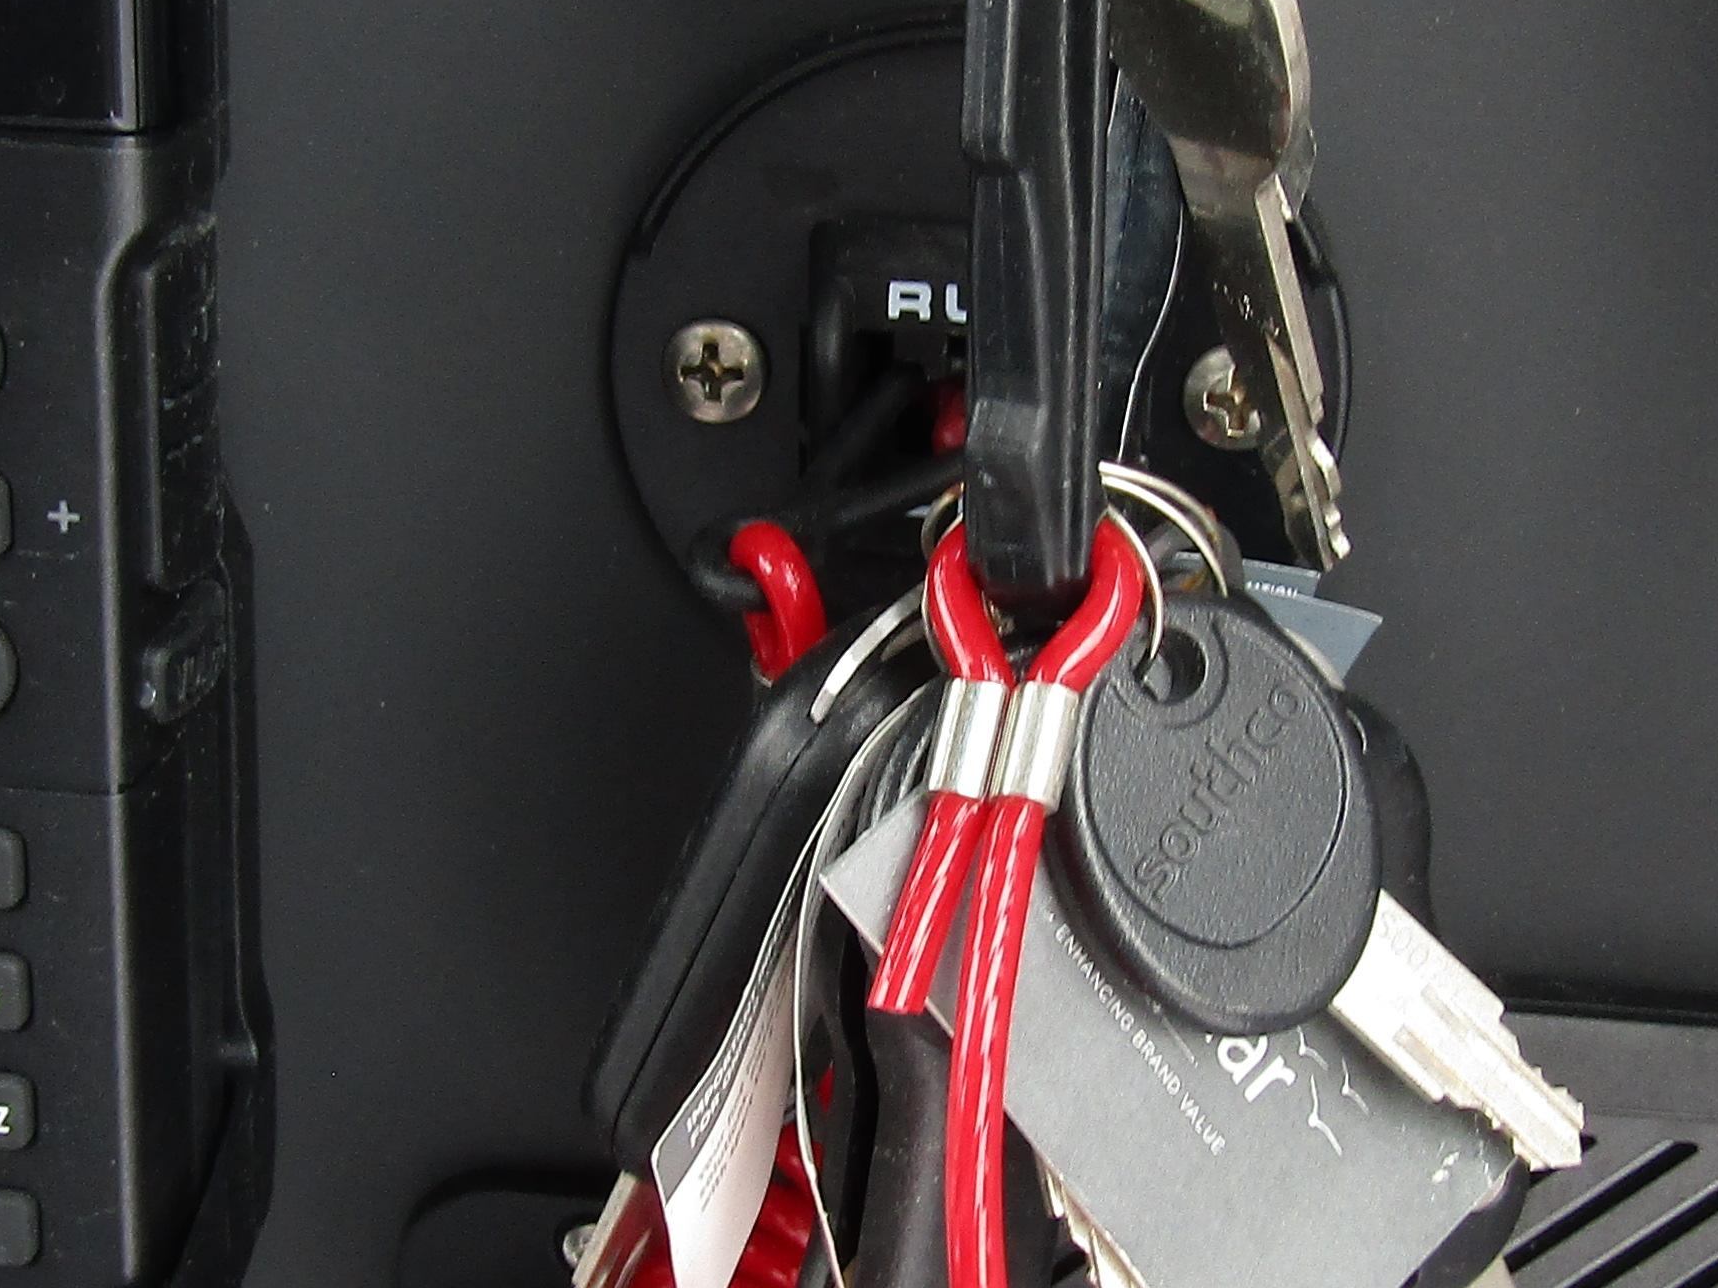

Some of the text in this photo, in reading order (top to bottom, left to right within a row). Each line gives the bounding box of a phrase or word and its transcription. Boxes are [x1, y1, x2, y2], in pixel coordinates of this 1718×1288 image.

[1134, 683, 1307, 902] southco
[1055, 923, 1226, 1156] ENHANCING BRAND VALUE
[1205, 1032, 1296, 1104] ar
